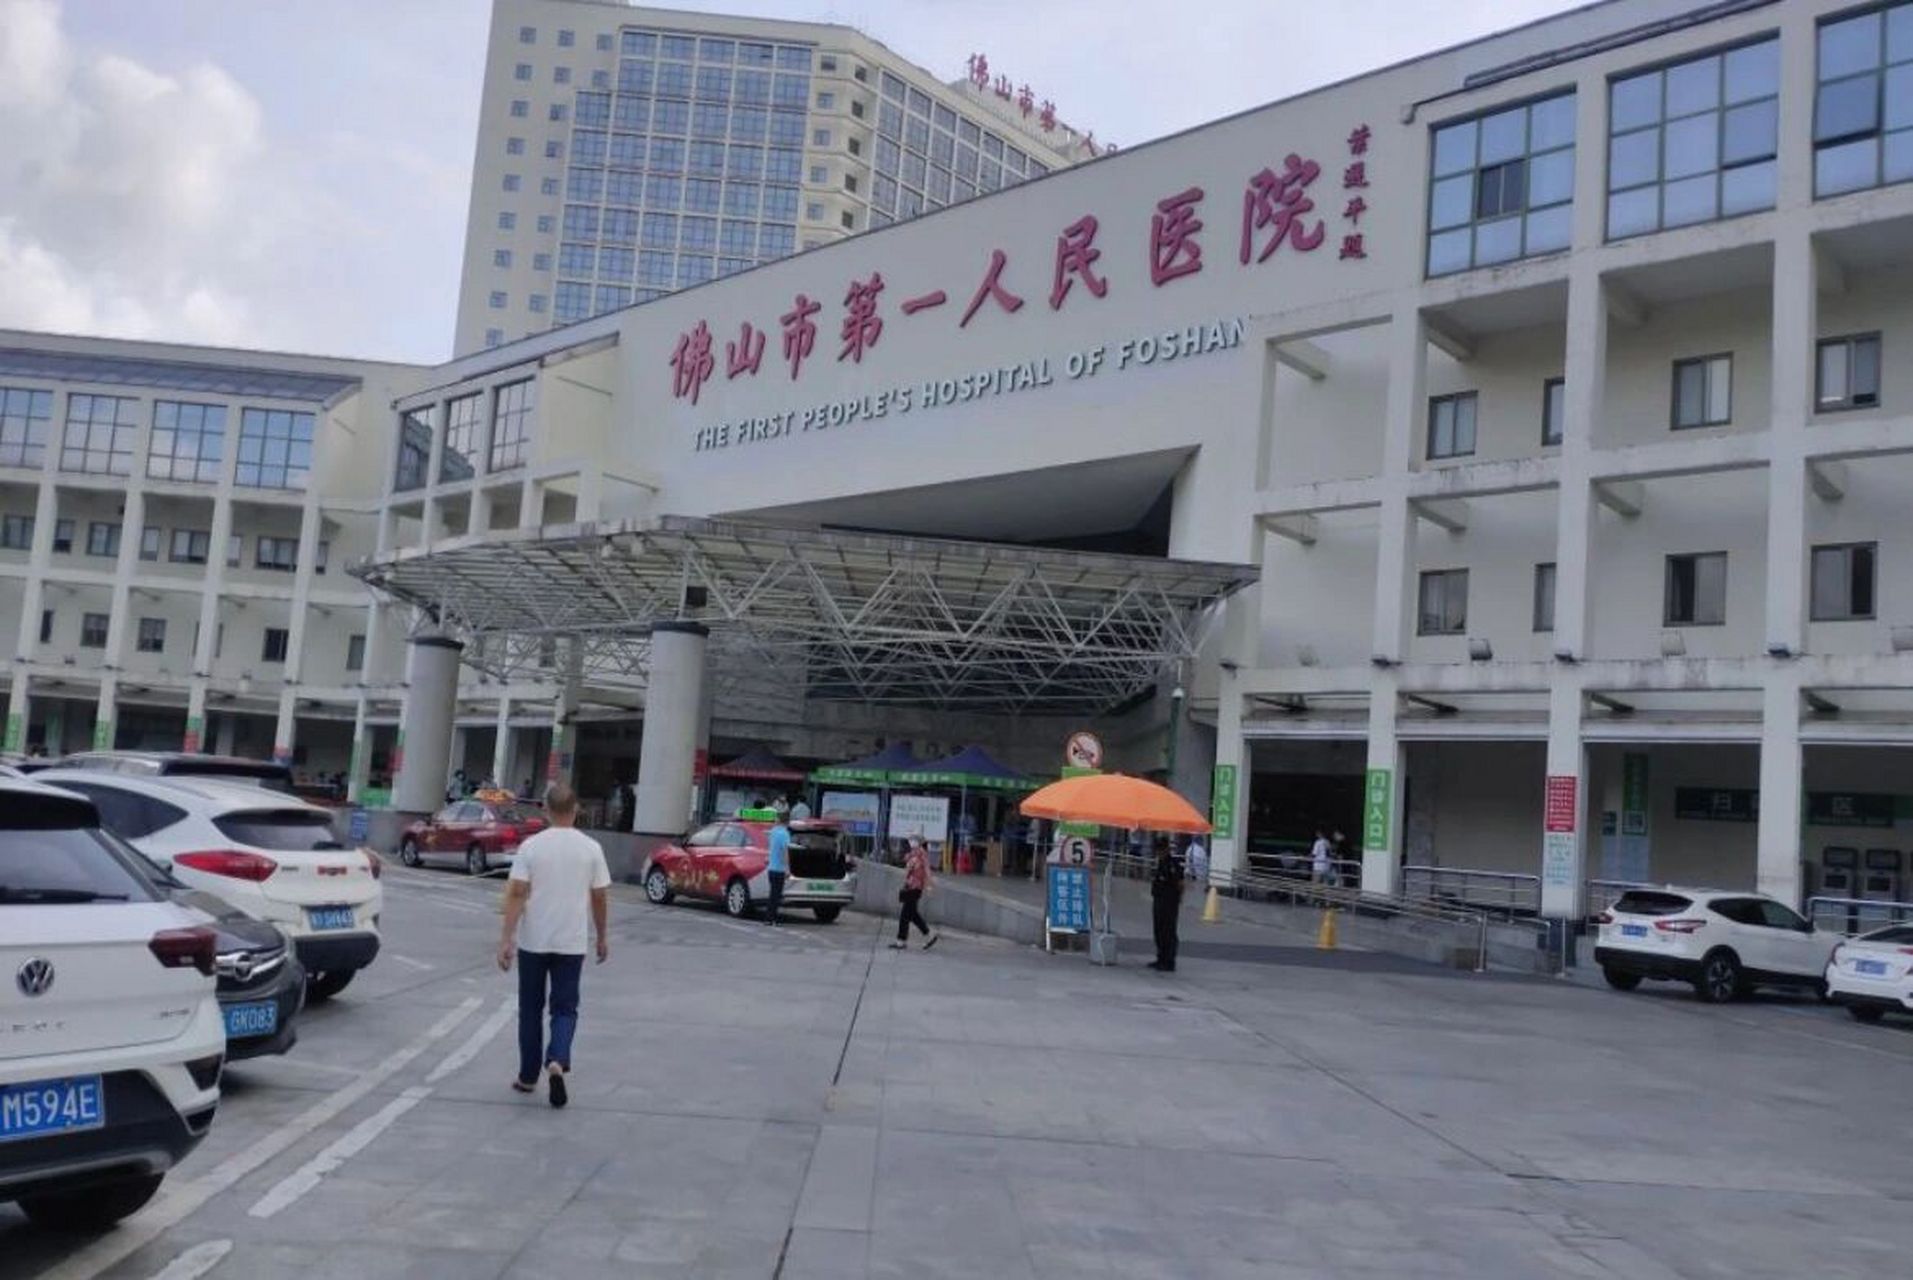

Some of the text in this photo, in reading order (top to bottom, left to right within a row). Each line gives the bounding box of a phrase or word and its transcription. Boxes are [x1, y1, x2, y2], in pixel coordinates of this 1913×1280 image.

[668, 152, 1326, 405] 佛山市第一人民医院
[696, 313, 1252, 451] THE FIRST PEOPLE'S HOSPITAL OF FOSHAN
[1072, 841, 1085, 865] 5
[3, 1084, 97, 1130] M594E
